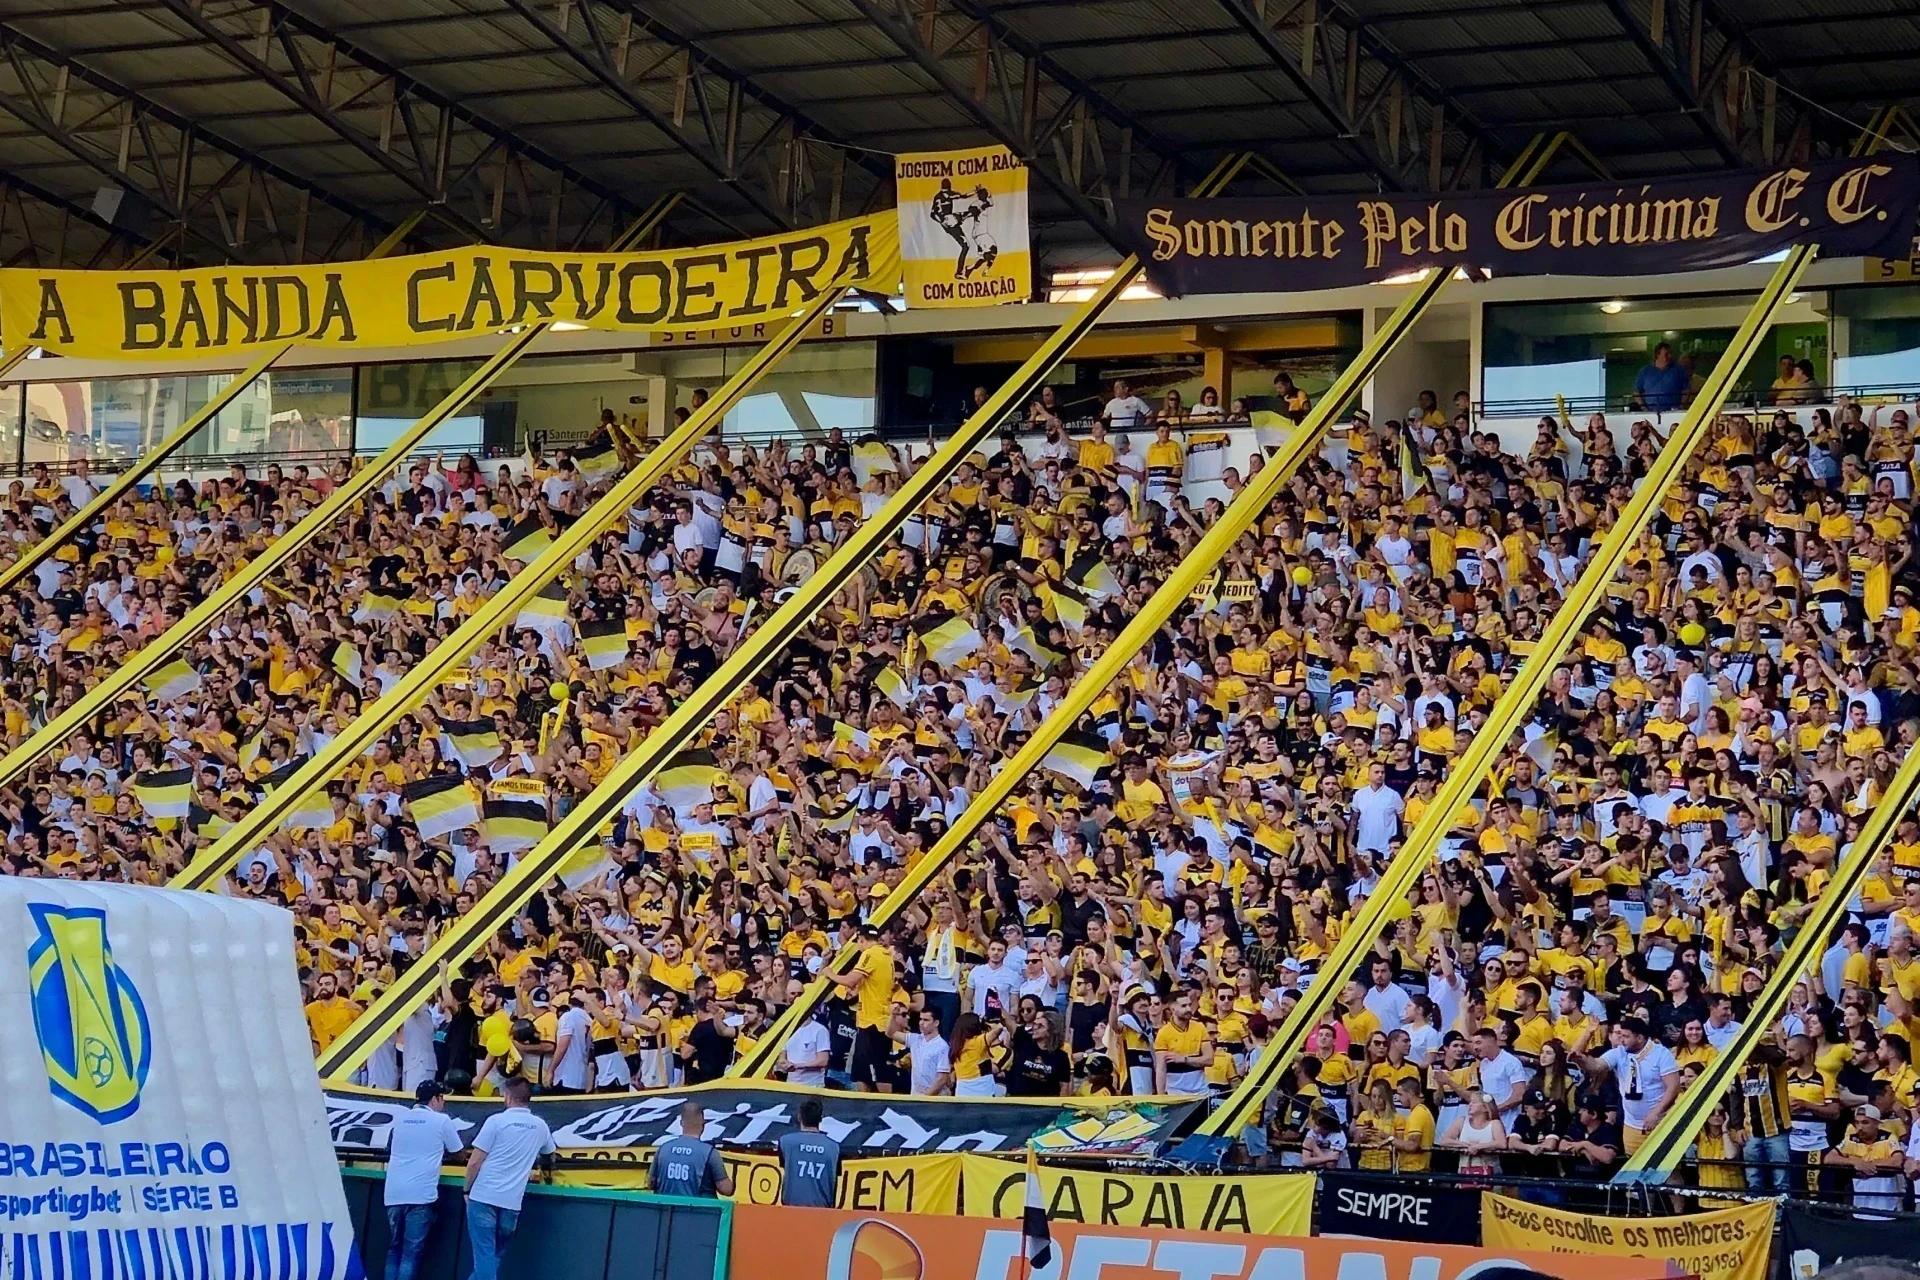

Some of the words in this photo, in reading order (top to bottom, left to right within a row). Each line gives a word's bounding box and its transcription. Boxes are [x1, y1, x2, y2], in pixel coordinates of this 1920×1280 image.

[898, 161, 954, 179] JOGUEM
[957, 157, 988, 176] COM
[1145, 206, 1344, 261] Somente
[1359, 201, 1467, 268] Pelo
[1496, 185, 1718, 252] Criciúma
[1746, 168, 1810, 233] E.
[1827, 164, 1892, 225] C.
[29, 279, 74, 344] A
[117, 273, 357, 350] BANDA
[407, 225, 872, 333] CARVOEIRA
[923, 283, 954, 300] COM
[958, 276, 1015, 300] CORAÇÃO
[822, 318, 834, 335] B
[549, 428, 590, 440] Santerra
[671, 1145, 693, 1156] FOTO
[799, 1143, 825, 1154] FOTO
[667, 1163, 690, 1182] 606
[797, 1160, 826, 1180] 747
[142, 1182, 213, 1212] SÉRIE
[219, 1185, 239, 1209] B
[1337, 1187, 1432, 1226] SEMPRE
[1543, 1216, 1615, 1246] escolhe
[1623, 1227, 1650, 1248] os
